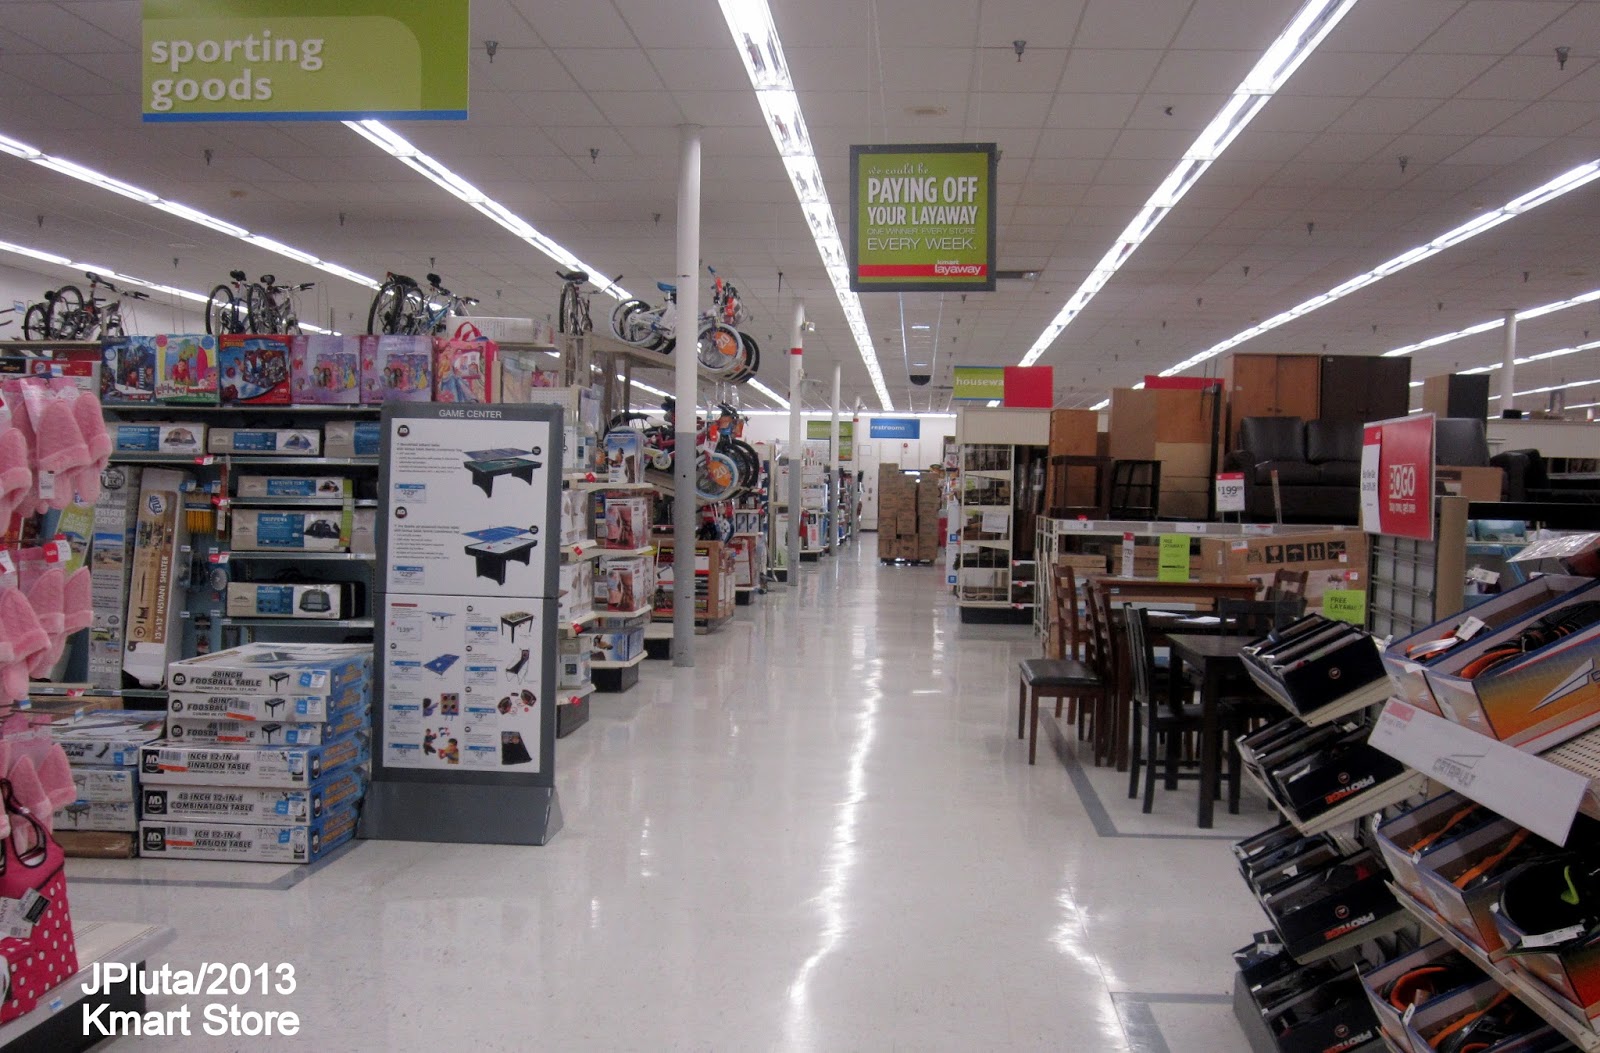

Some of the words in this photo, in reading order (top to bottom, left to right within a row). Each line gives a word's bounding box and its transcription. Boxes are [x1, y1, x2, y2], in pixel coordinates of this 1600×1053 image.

[151, 28, 324, 72] sporting
[150, 68, 273, 111] goods
[885, 163, 914, 174] could
[868, 177, 938, 203] PAYING
[943, 176, 978, 203] OFF
[867, 206, 907, 225] YOUR
[911, 205, 978, 225] LAYAWAY
[867, 237, 920, 250] EVERY
[925, 237, 977, 250] WEEK.
[934, 263, 981, 275] layaway
[955, 376, 1004, 386] housewa
[438, 409, 465, 418] GAME
[466, 409, 502, 419] CENTER
[713, 466, 728, 480] 20
[158, 555, 169, 585] SHELTER
[157, 585, 167, 617] INSTANT
[190, 677, 234, 686] FOOSBALL
[235, 679, 262, 687] TABLE
[227, 762, 251, 771] TABLE
[190, 792, 211, 801] INCH
[170, 801, 228, 810] COMBINATION
[230, 803, 254, 812] TABLE
[229, 840, 252, 849] TABLE
